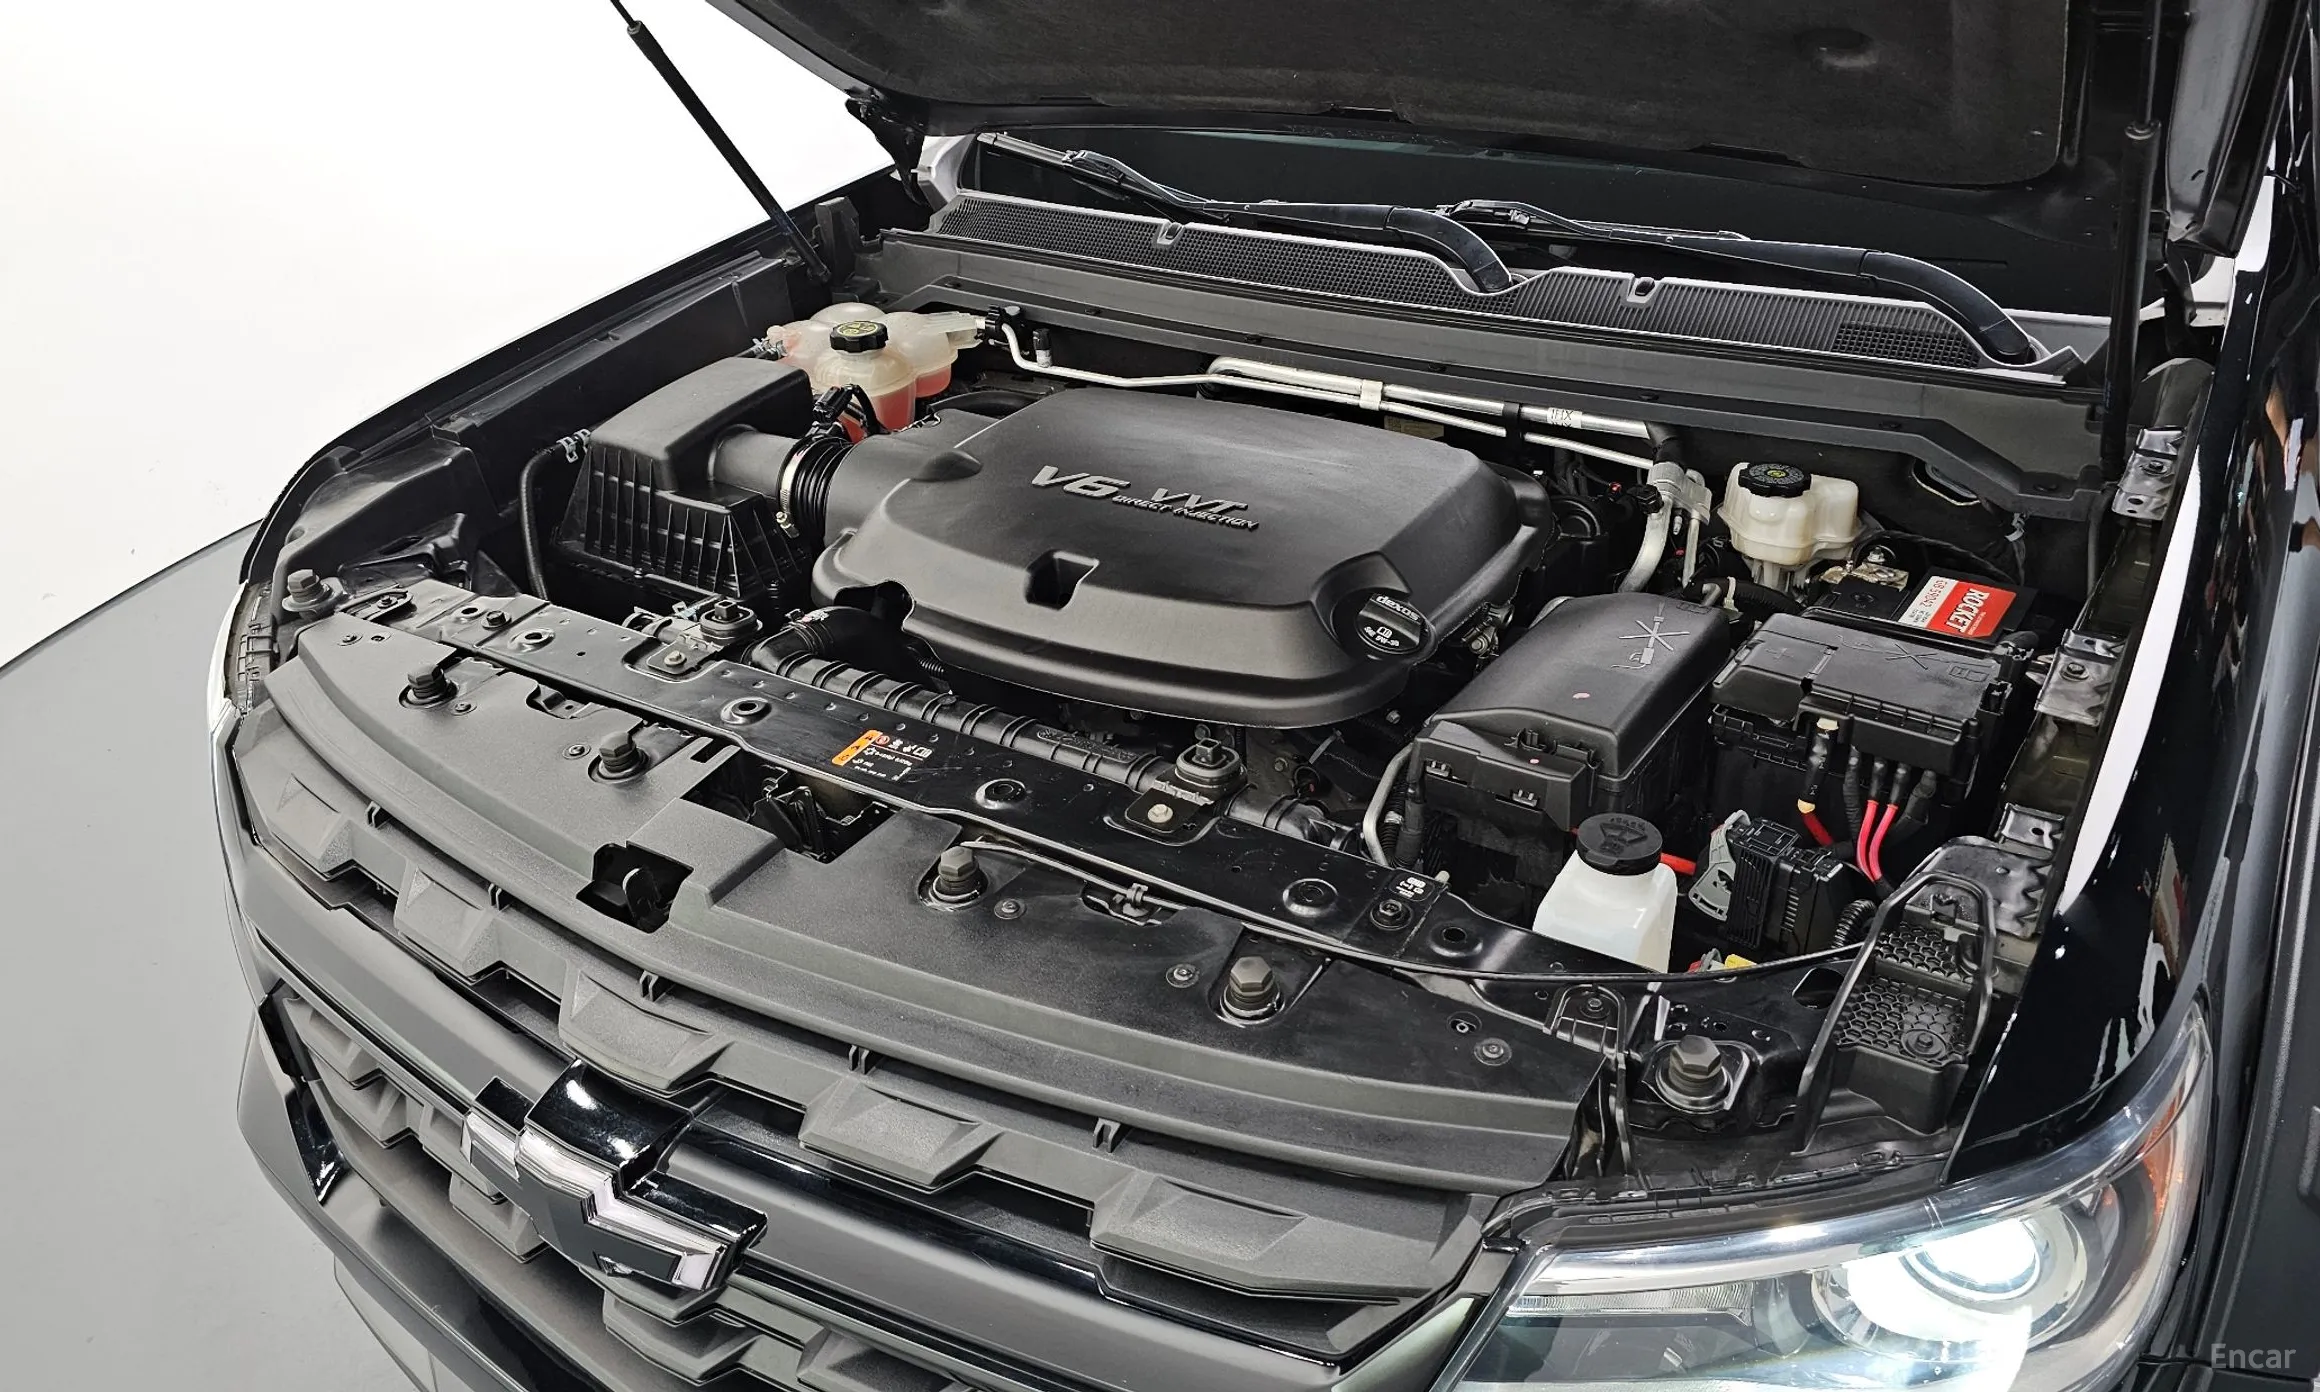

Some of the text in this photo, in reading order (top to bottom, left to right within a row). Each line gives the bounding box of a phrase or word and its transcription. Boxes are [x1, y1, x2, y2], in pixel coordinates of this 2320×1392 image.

[1032, 465, 1248, 514] V6 VVT
[1112, 493, 1259, 531] DIRECT INJECTION
[1376, 595, 1421, 621] dexos
[1945, 587, 1991, 634] ROCKET
